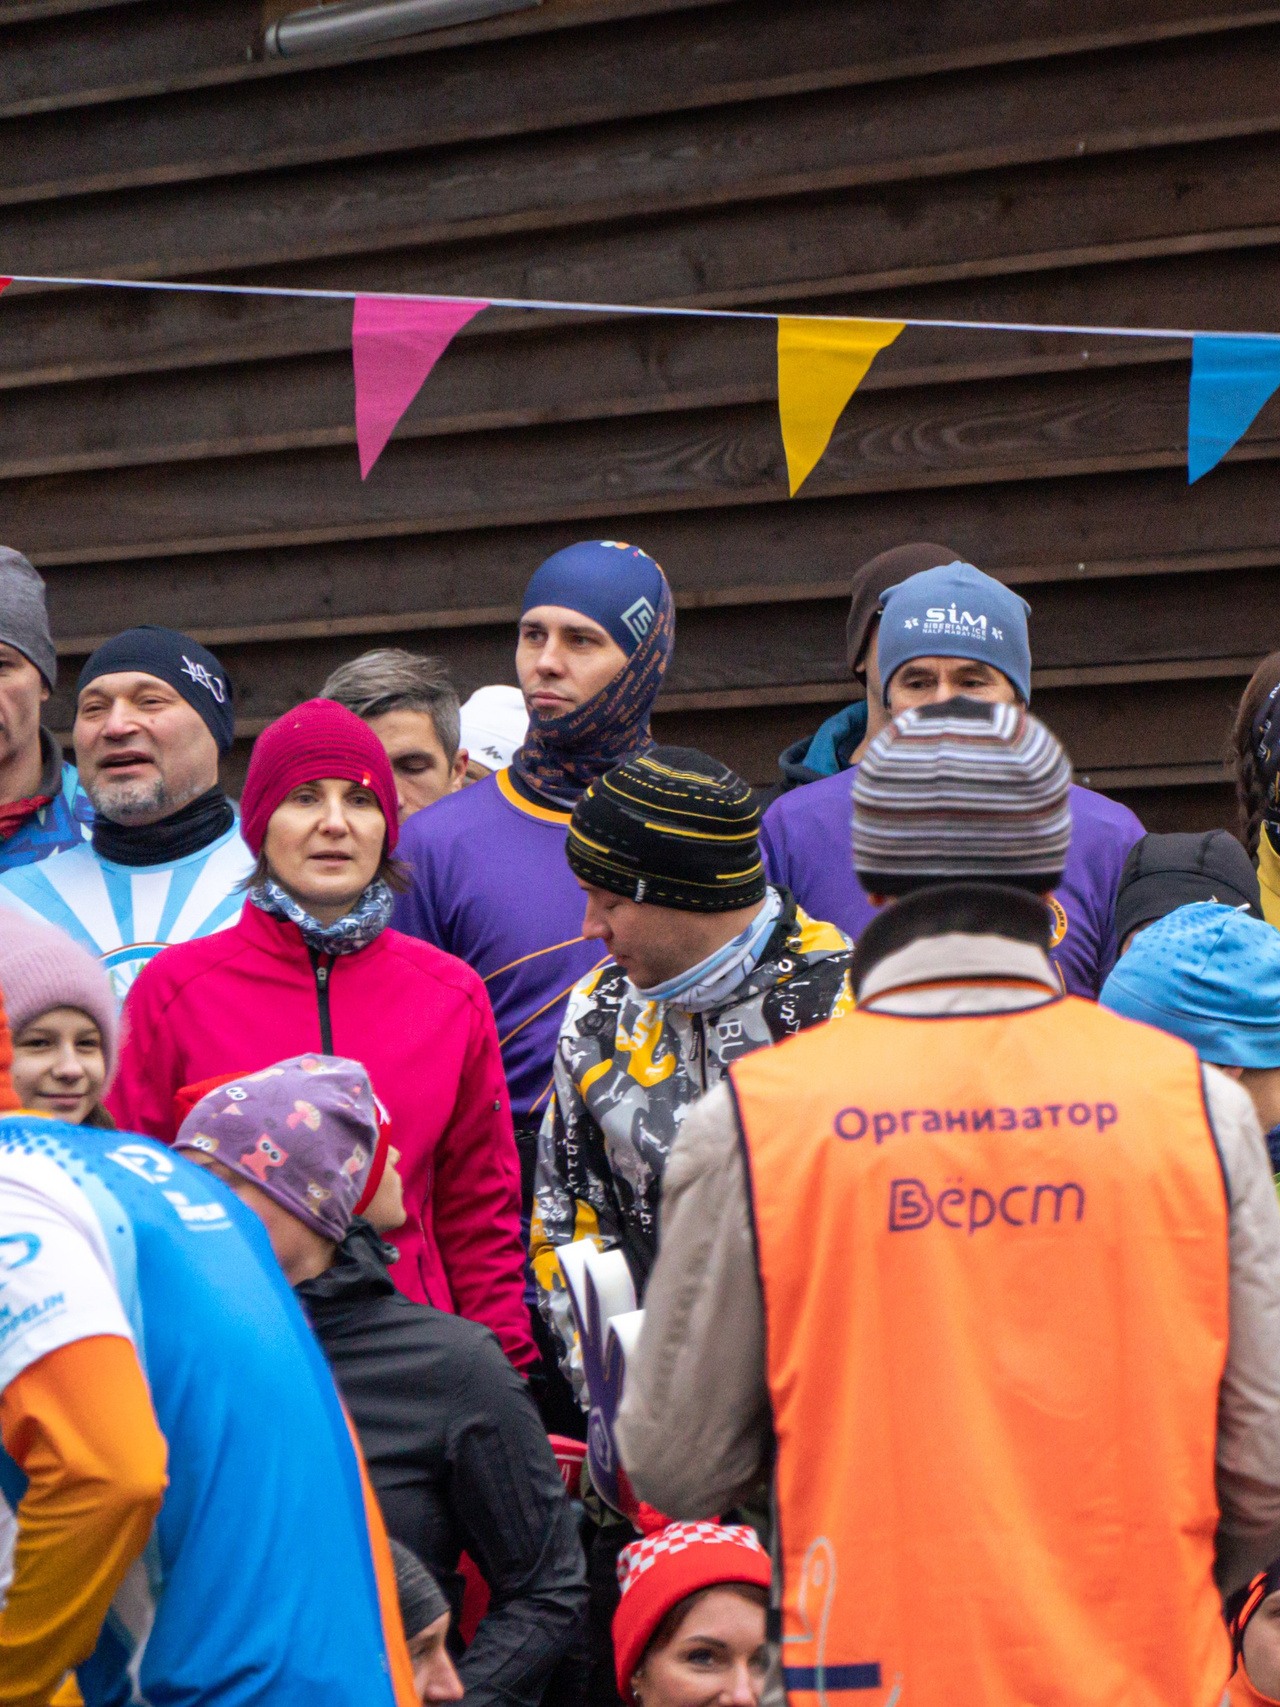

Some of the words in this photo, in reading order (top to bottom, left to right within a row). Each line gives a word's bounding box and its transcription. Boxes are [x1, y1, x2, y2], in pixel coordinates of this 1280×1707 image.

[923, 622, 969, 632] SIBERIAN
[972, 626, 986, 636] ICE
[833, 1101, 1119, 1145] Организатор
